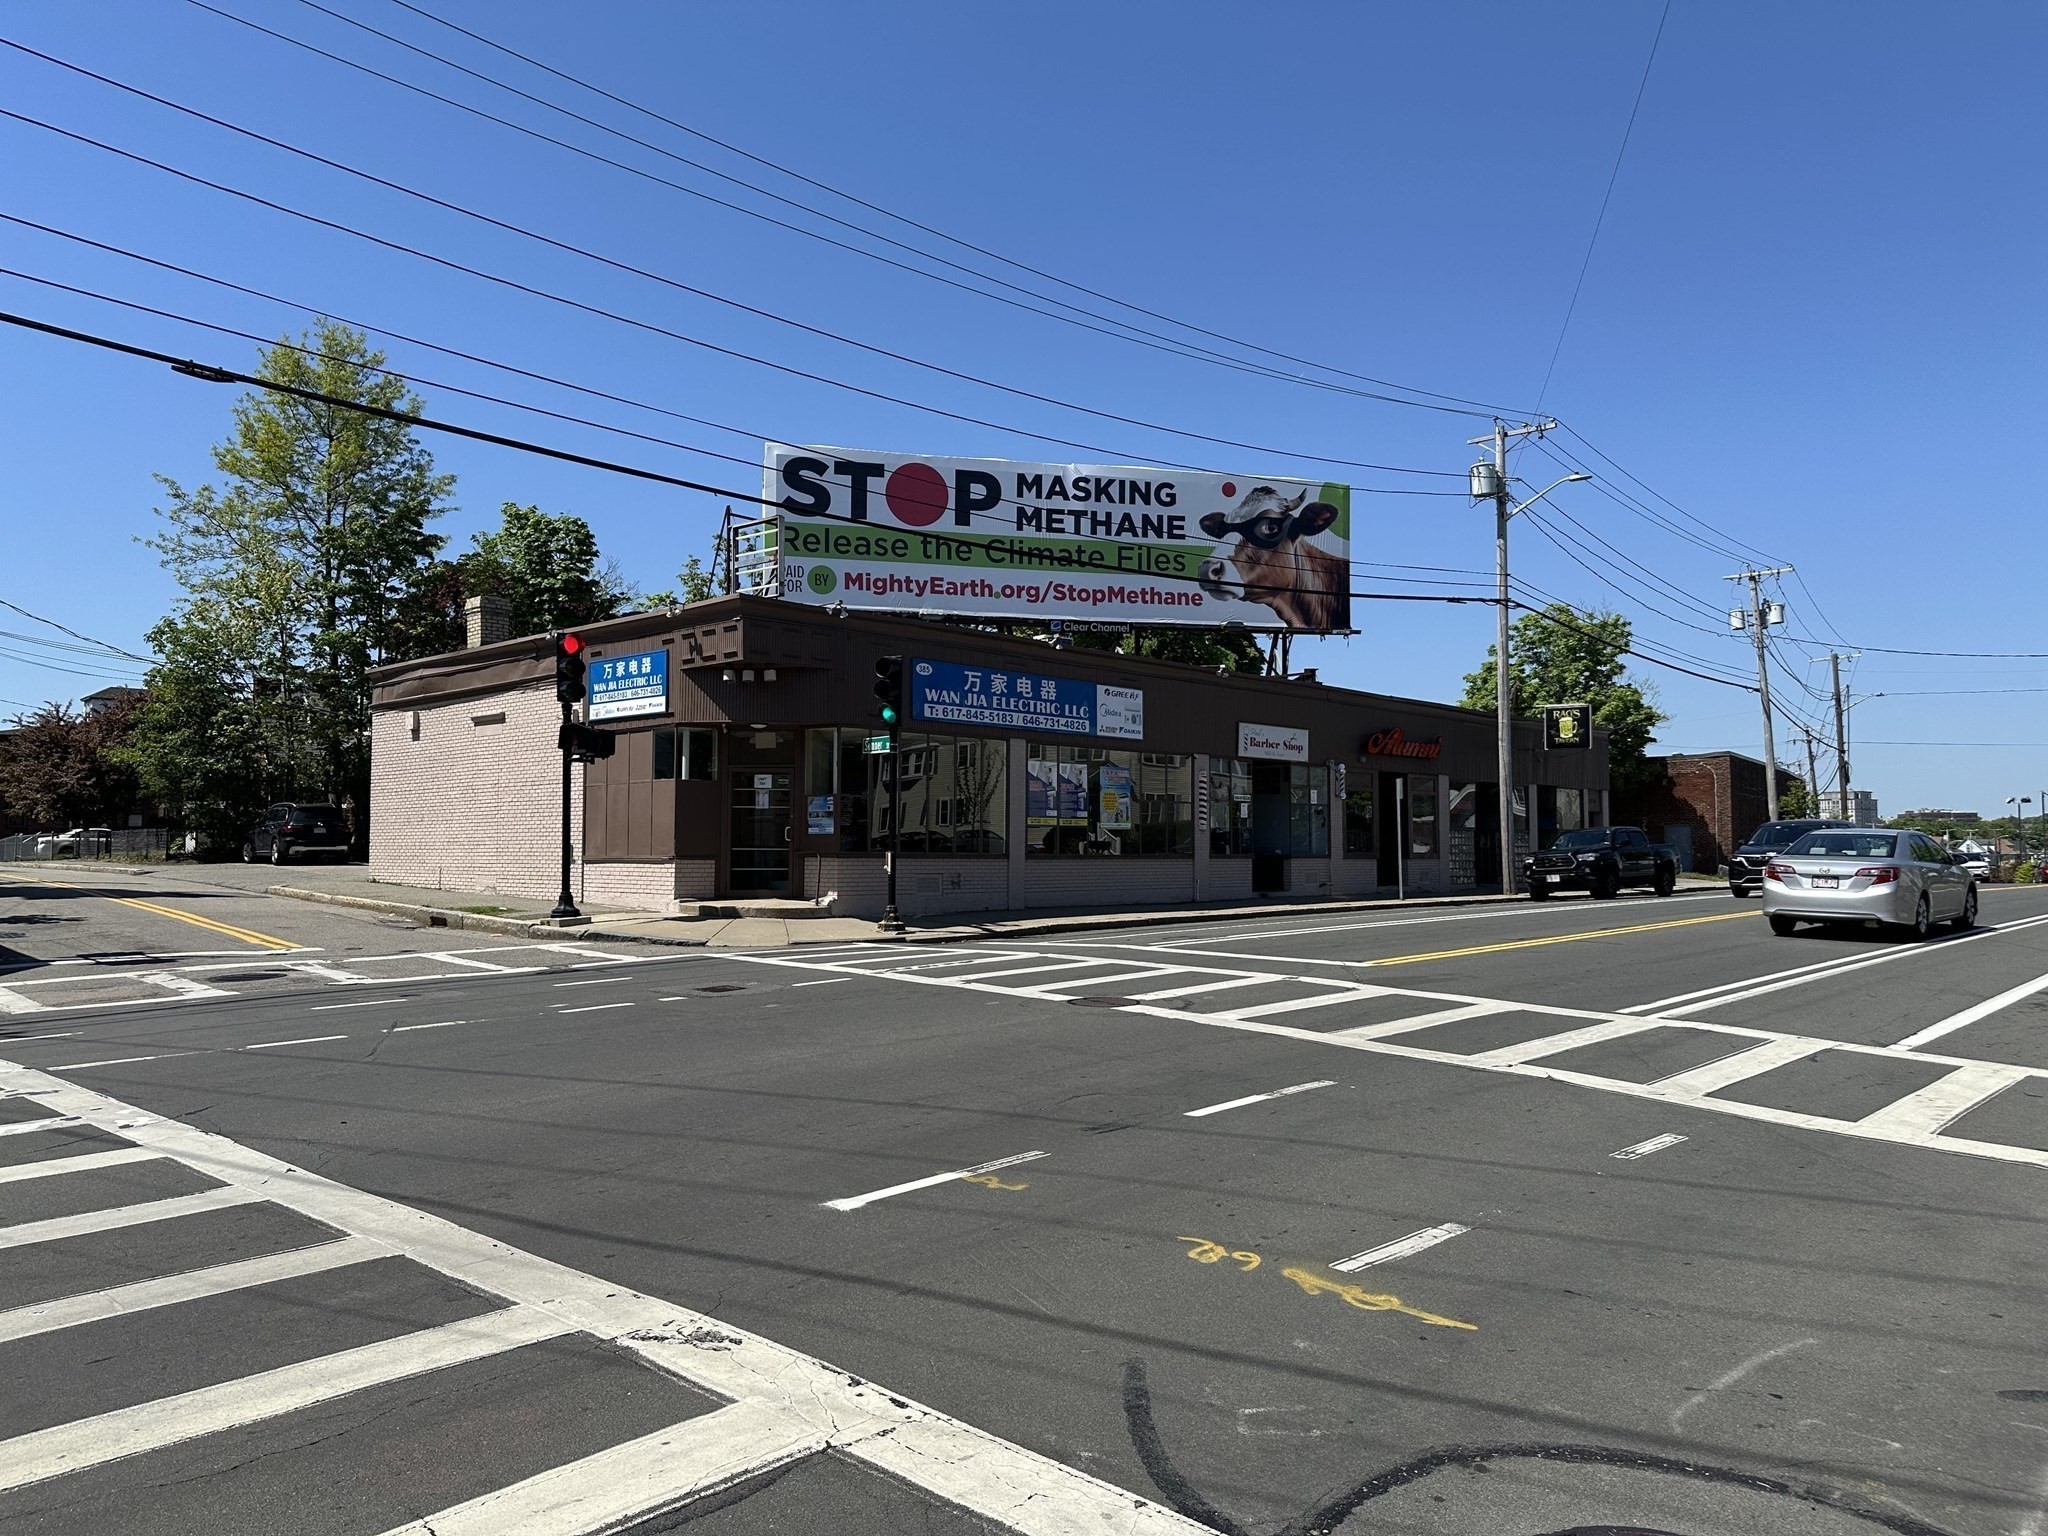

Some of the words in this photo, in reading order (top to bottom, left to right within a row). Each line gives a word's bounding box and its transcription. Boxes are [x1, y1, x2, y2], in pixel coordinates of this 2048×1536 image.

[782, 456, 1002, 526] STOP
[1016, 473, 1177, 507] MASKING
[1016, 506, 1186, 540] METHANE
[784, 526, 909, 558] Release
[921, 534, 972, 561] the
[985, 538, 1105, 569] Climate
[1118, 545, 1186, 572] Files
[784, 565, 805, 578] AID
[814, 573, 829, 586] BY
[844, 572, 1204, 607] MightyEarth.org/StopMethane
[1063, 622, 1089, 632] Clear
[1090, 622, 1130, 633] Channel
[603, 657, 652, 680] 万家电器
[918, 665, 931, 673] 385
[593, 682, 607, 693] WAN
[608, 681, 617, 691] JIA
[618, 675, 649, 690] ELECTRIC
[650, 674, 663, 685] LLC
[599, 691, 628, 702] 617-845-5183
[631, 687, 662, 697] 646-731-4826
[963, 670, 1057, 701] 万家电器
[1111, 690, 1129, 698] GREE
[925, 688, 960, 704] WAN
[964, 693, 987, 707] JIA
[992, 696, 1061, 715] ELECTRIC
[1065, 704, 1089, 718] LLC
[928, 706, 939, 716] T:
[942, 707, 1014, 724] 617-845-5183
[1022, 716, 1087, 731] 646-731-4826
[1249, 736, 1280, 749] Barber
[1283, 740, 1304, 753] Shop
[1367, 727, 1443, 760] Alumni
